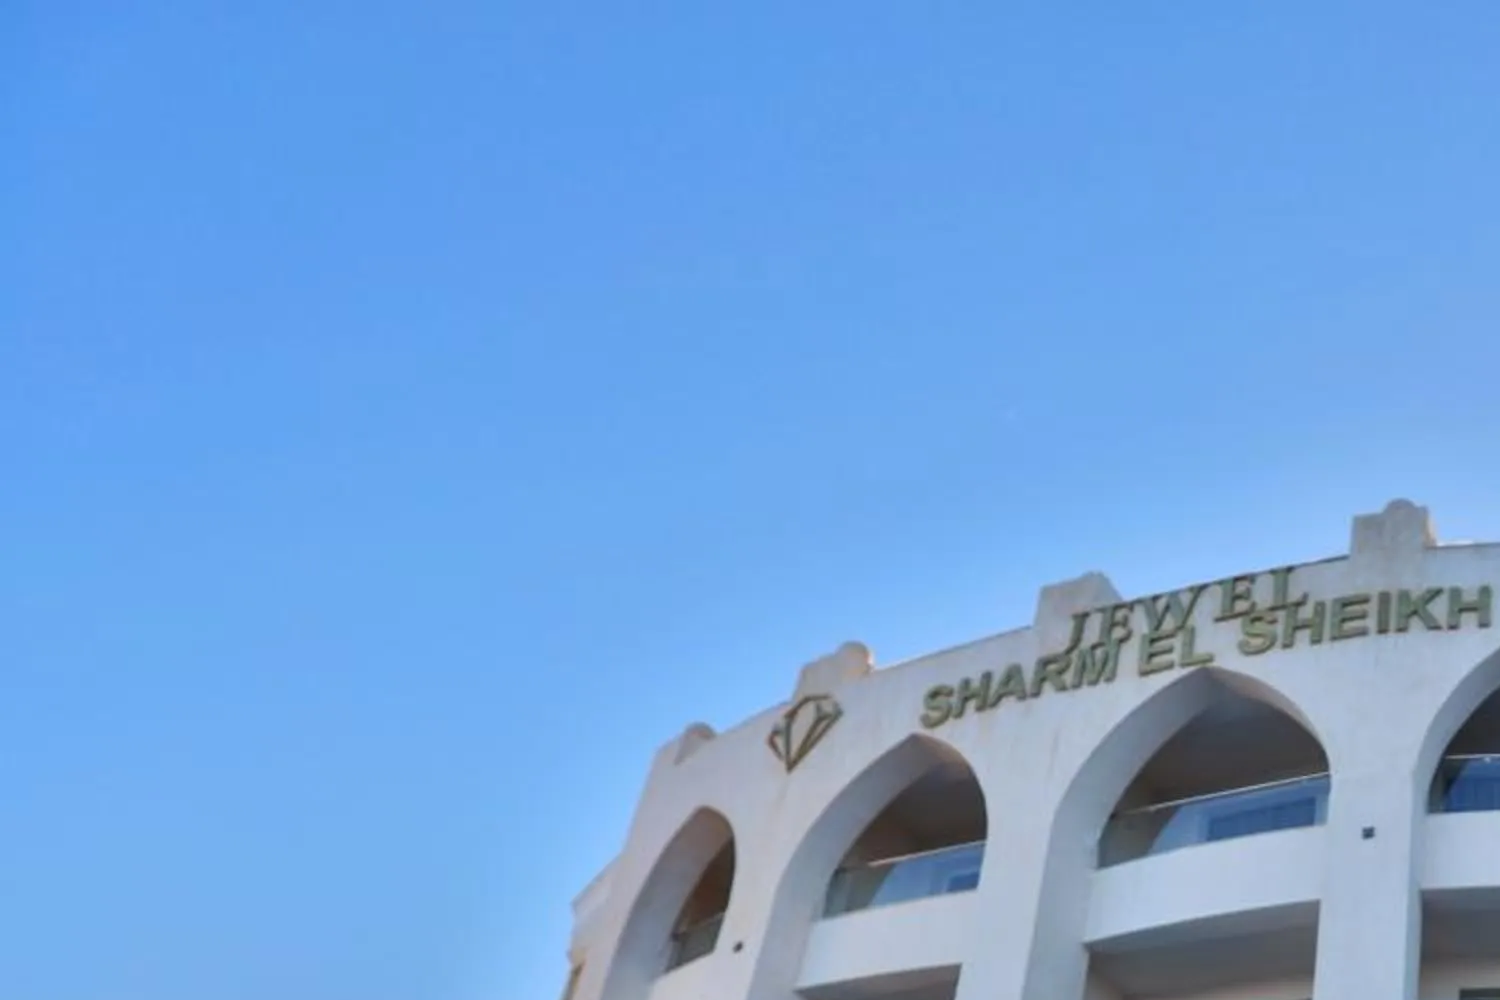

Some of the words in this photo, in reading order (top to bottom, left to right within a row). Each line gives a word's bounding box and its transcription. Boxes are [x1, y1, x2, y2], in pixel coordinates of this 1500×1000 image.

[920, 633, 1123, 729] SHARM
[1138, 625, 1214, 677] EL
[1237, 584, 1493, 656] SHEIKH
[1064, 566, 1309, 654] JEWEL
